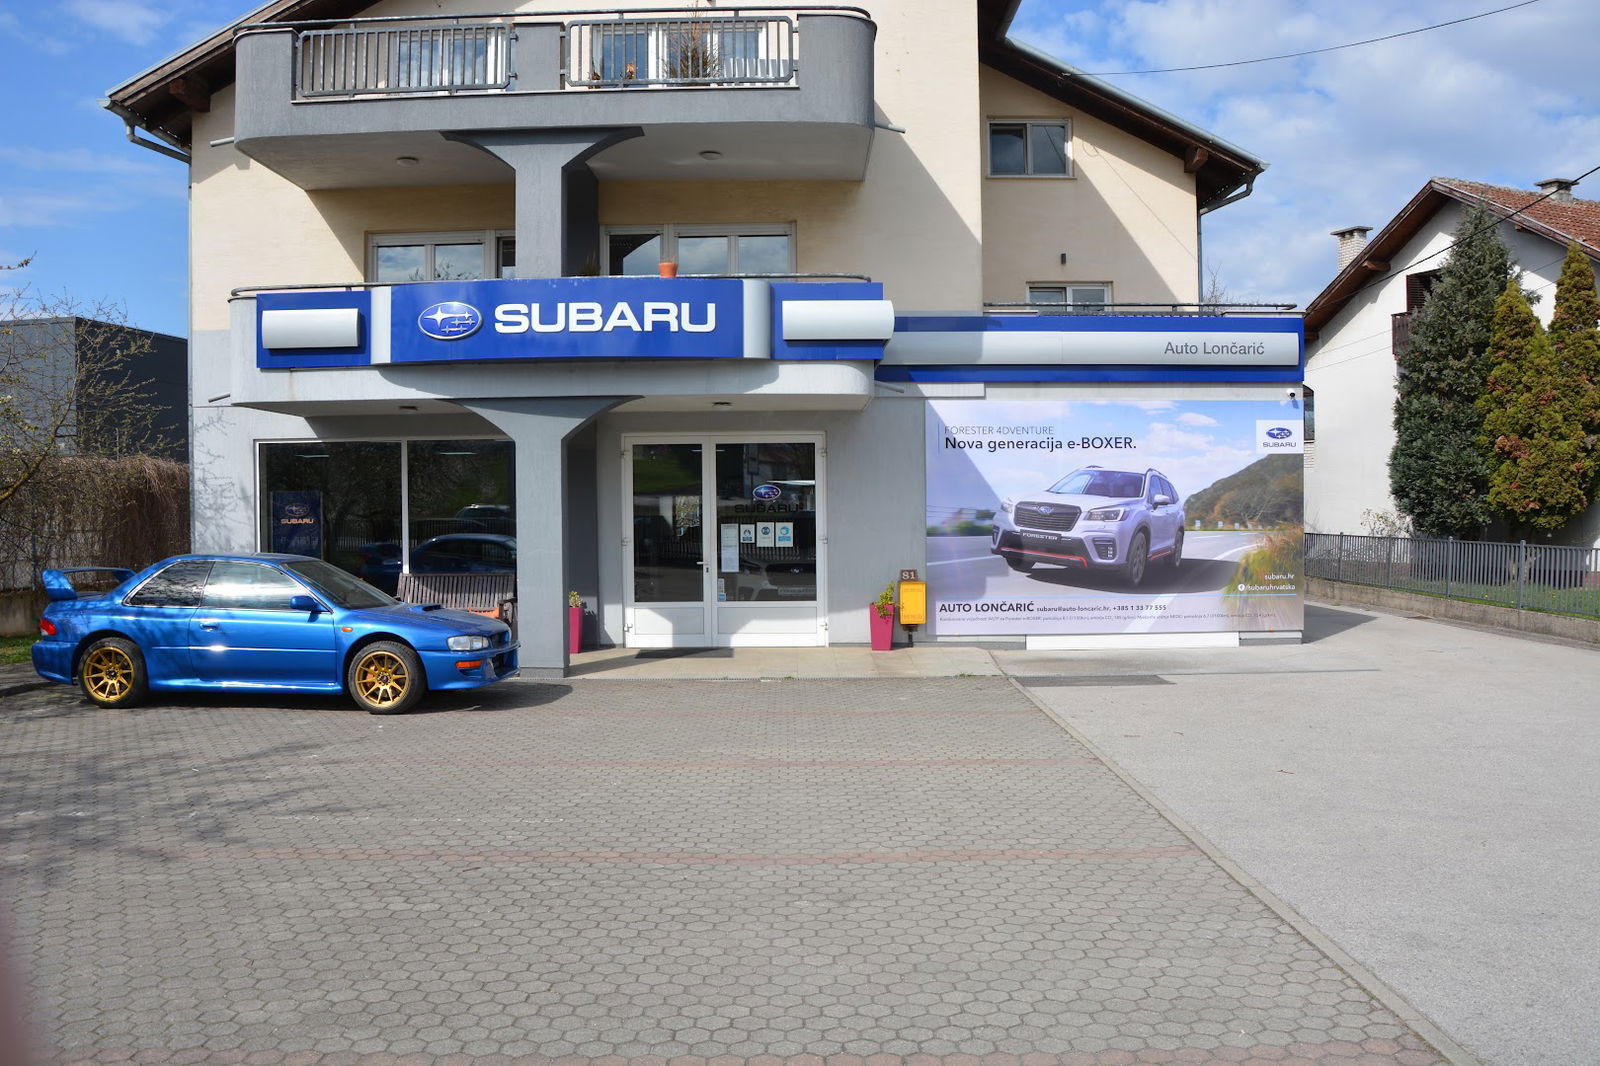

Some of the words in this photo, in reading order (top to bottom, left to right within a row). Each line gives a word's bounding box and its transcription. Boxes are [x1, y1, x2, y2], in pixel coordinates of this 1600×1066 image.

[494, 302, 716, 333] SUBARU
[1164, 342, 1198, 355] Auto
[1203, 342, 1265, 355] Lončarić
[944, 426, 993, 435] FORESTER
[996, 426, 1054, 435] 4DVENTURE
[945, 438, 983, 449] Nova
[987, 437, 1063, 453] generacija
[1067, 437, 1137, 449] e-BOXER.
[734, 503, 799, 513] SUBARU
[1022, 532, 1058, 541] FORESTER
[1264, 572, 1295, 580] subaru.hr
[939, 603, 972, 613] AUTO
[975, 600, 1035, 612] LONČARIĆ
